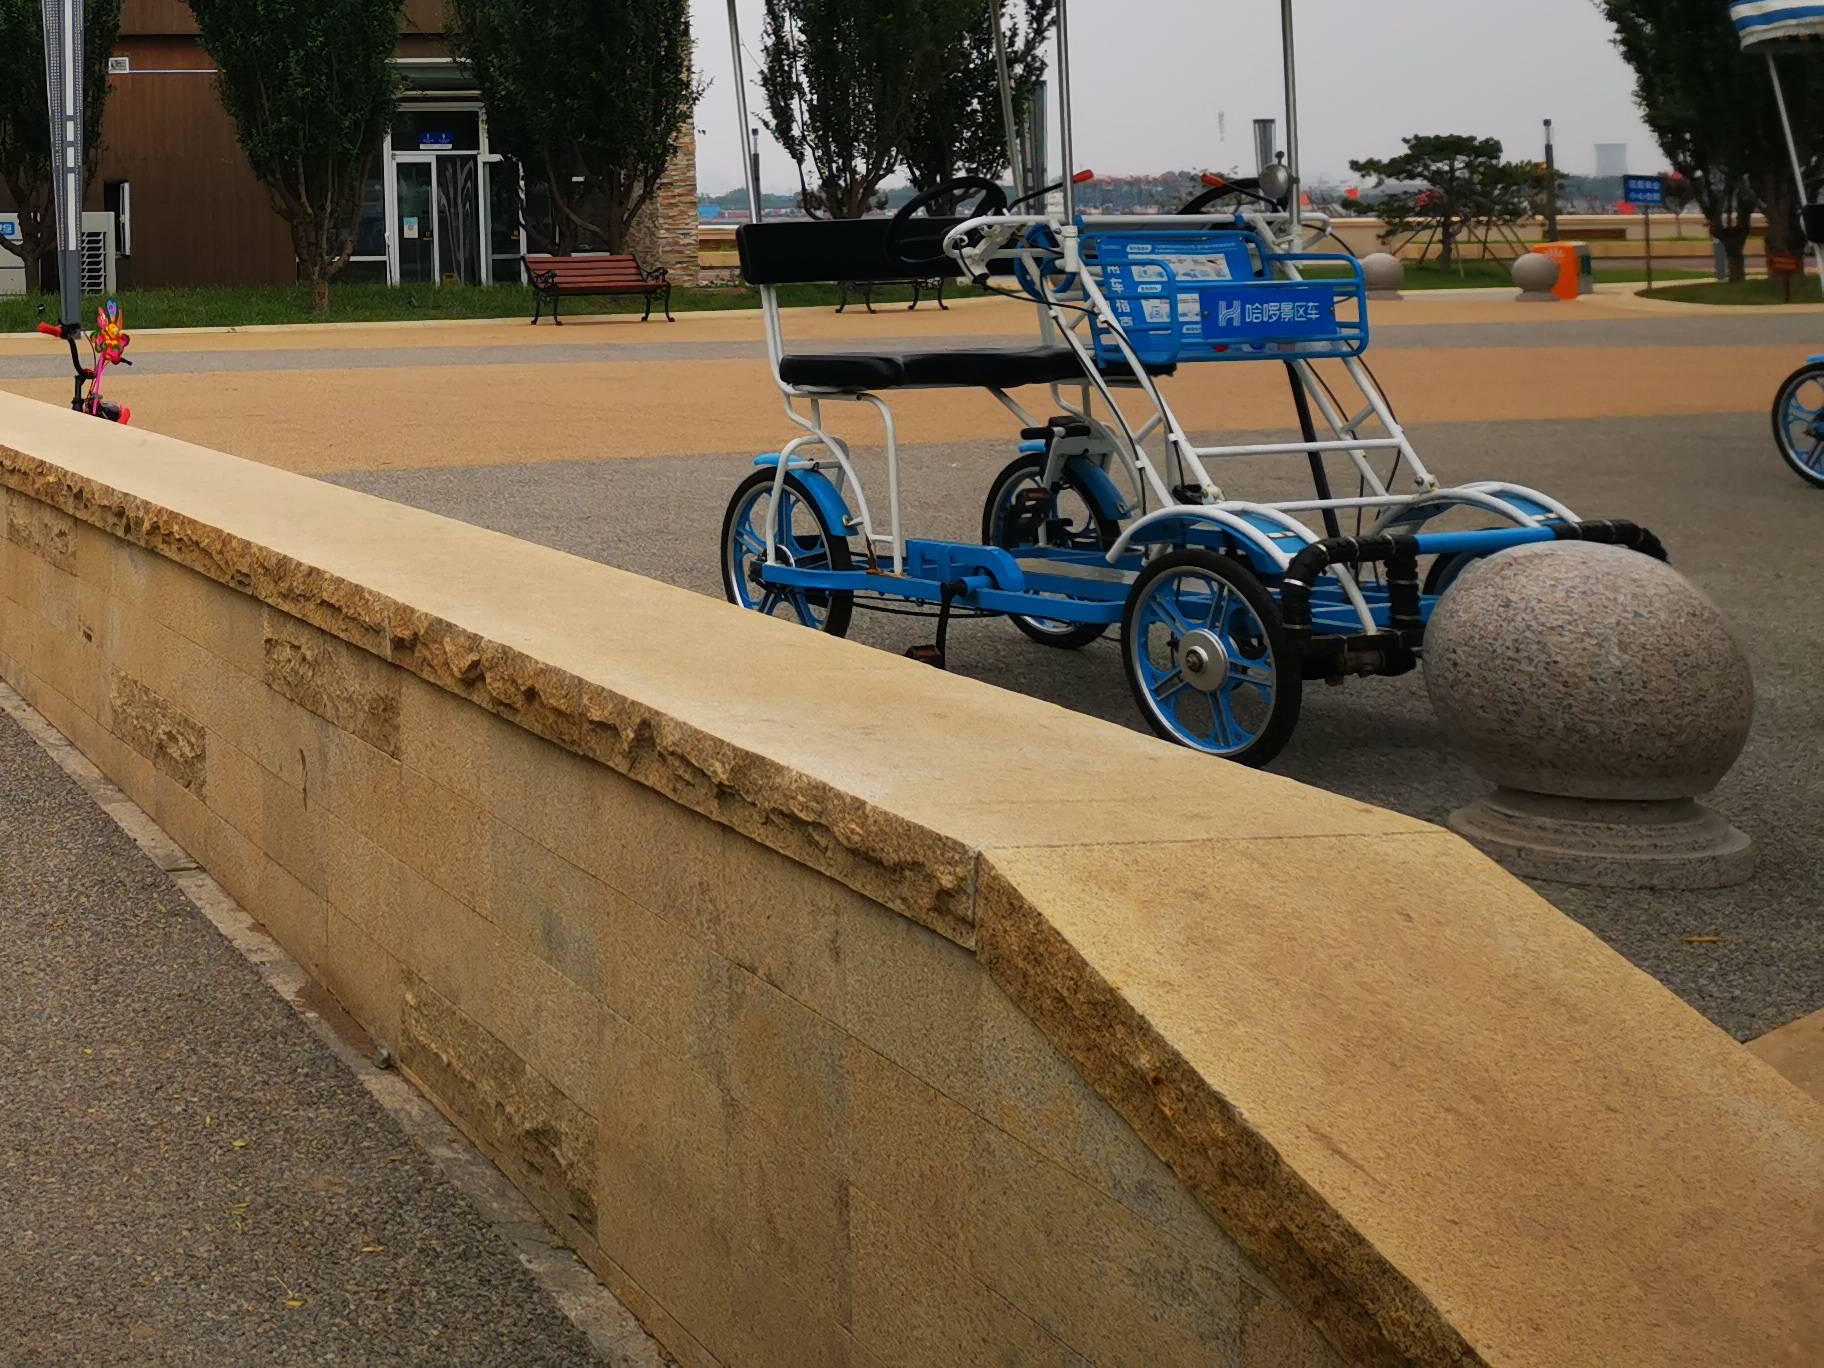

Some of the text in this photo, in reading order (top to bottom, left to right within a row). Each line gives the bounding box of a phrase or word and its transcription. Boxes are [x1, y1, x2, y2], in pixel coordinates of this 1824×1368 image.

[1245, 301, 1320, 322] 哈啰景区车
